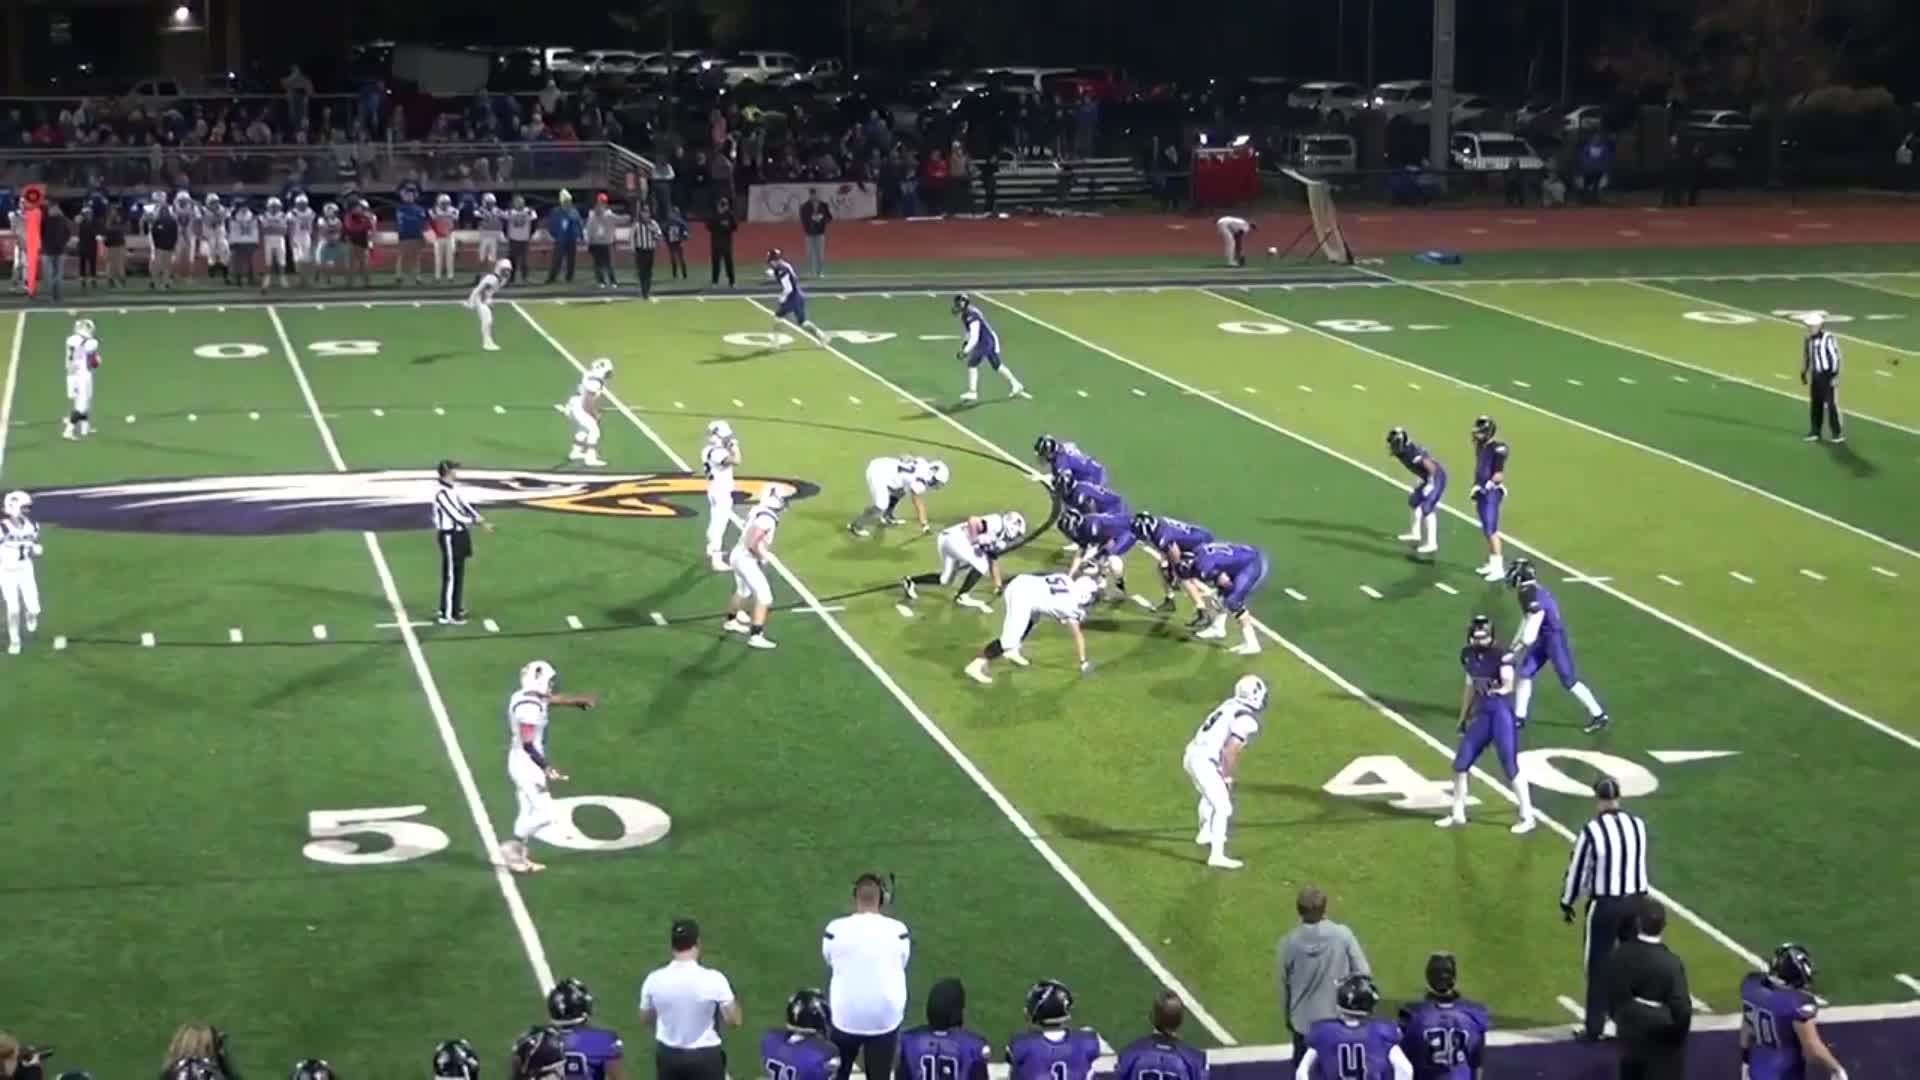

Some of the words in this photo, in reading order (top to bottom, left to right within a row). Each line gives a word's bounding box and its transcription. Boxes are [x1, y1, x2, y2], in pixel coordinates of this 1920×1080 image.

[193, 341, 381, 359] 50
[1044, 576, 1070, 596] 51
[1321, 747, 1660, 809] 40
[302, 795, 672, 864] 50
[1336, 1042, 1369, 1080] 4
